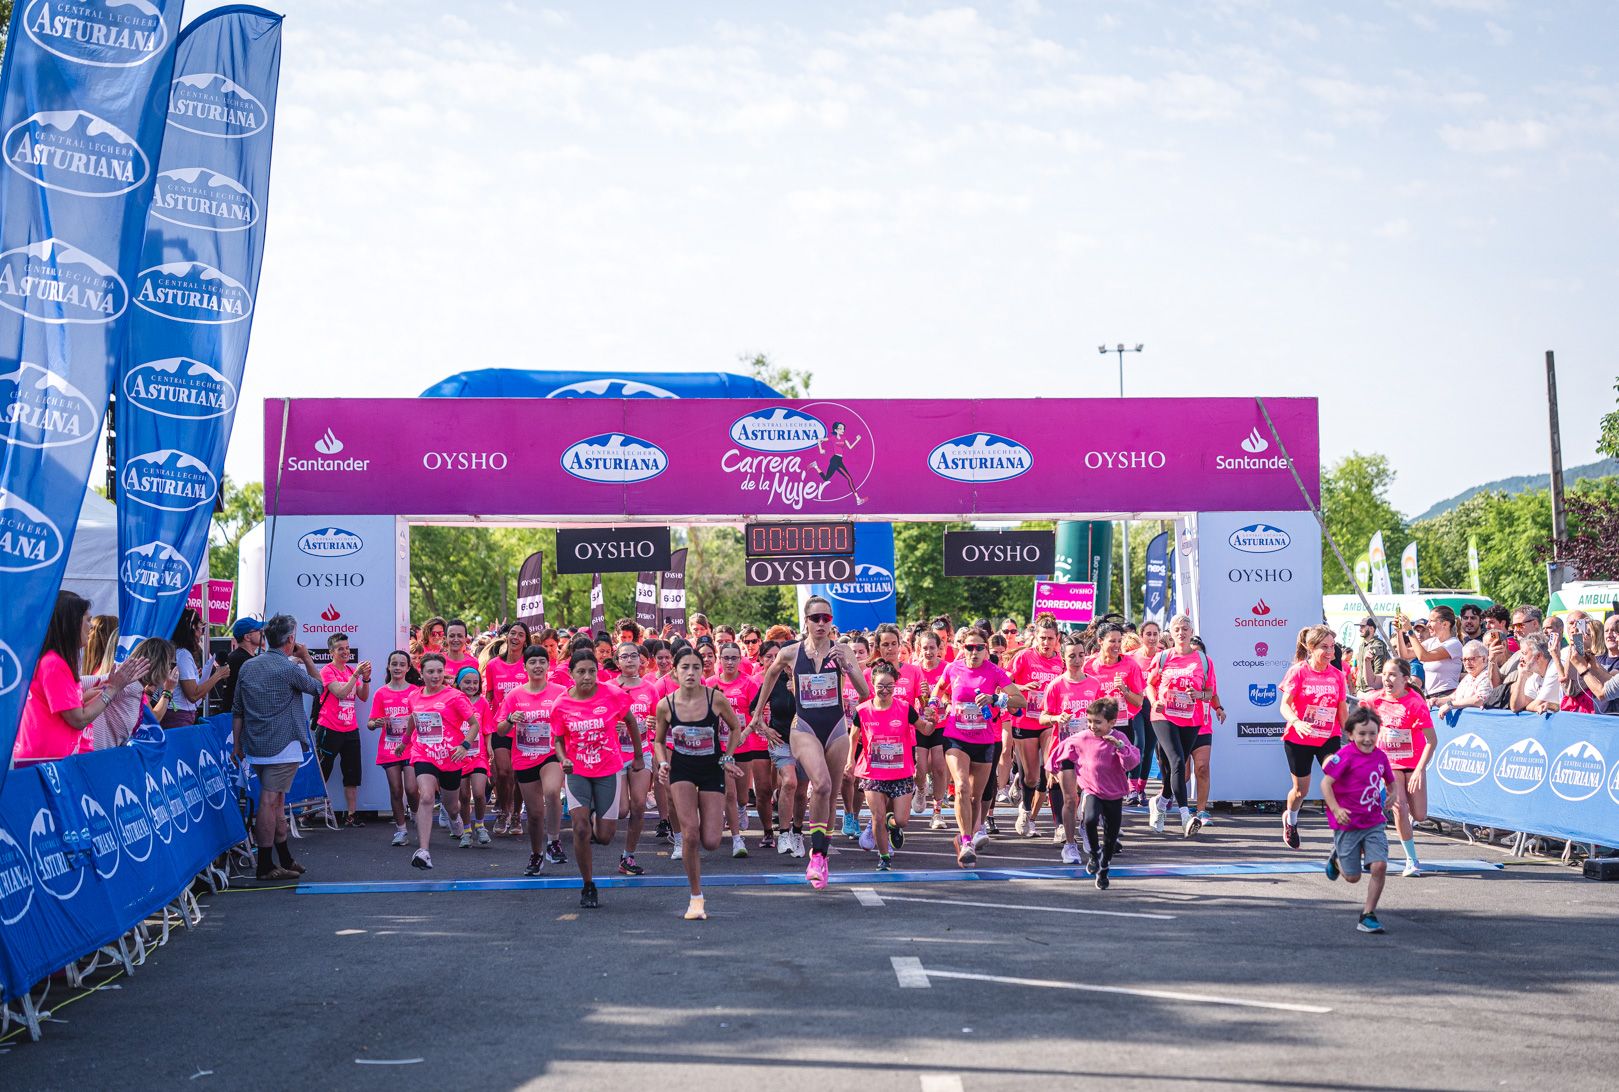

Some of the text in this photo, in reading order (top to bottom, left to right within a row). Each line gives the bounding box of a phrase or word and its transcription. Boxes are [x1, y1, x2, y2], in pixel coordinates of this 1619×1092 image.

[57, 3, 103, 19] CENTRAL
[31, 2, 155, 51] ASTURIANA
[180, 89, 219, 102] CENTRAL
[35, 130, 134, 157] CENTRAL LECHERA
[12, 131, 136, 183] ASTURIANA
[167, 183, 207, 196] CENTRAL
[58, 269, 115, 290] LECHERA
[158, 278, 242, 297] CENTRAL LECHERA
[137, 278, 243, 316] ASTURIANA
[130, 374, 228, 409] ASTURIANA
[150, 374, 226, 392] CENTRAL LECHERA
[738, 423, 819, 441] ASTURIANA
[287, 456, 370, 472] Santander
[422, 451, 508, 470] OYSHO
[569, 451, 660, 471] ASTURIANA
[720, 448, 802, 474] Carrera
[936, 451, 1025, 470] ASTURIANA
[1084, 451, 1166, 469] OYSHO
[740, 470, 831, 510] de la Mujer
[303, 538, 358, 550] ASTURIANA
[1233, 534, 1286, 546] ASTURIANA
[574, 540, 655, 560] OYSHO
[962, 545, 1040, 563] OYSHO
[751, 559, 850, 582] OYSHO
[1228, 568, 1293, 583] OYSHO
[297, 572, 365, 588] OYSHO
[1070, 587, 1093, 595] OYSHO
[1036, 599, 1093, 610] CORREDORAS
[302, 623, 359, 633] Santander
[1234, 617, 1288, 628] Santander
[1232, 660, 1265, 669] octopus
[419, 725, 432, 733] 016
[568, 717, 605, 732] CARRERA
[1439, 750, 1486, 774] ASTURIANA
[1497, 757, 1543, 781] ASTURIANA
[1552, 760, 1600, 787] ASTURIANA
